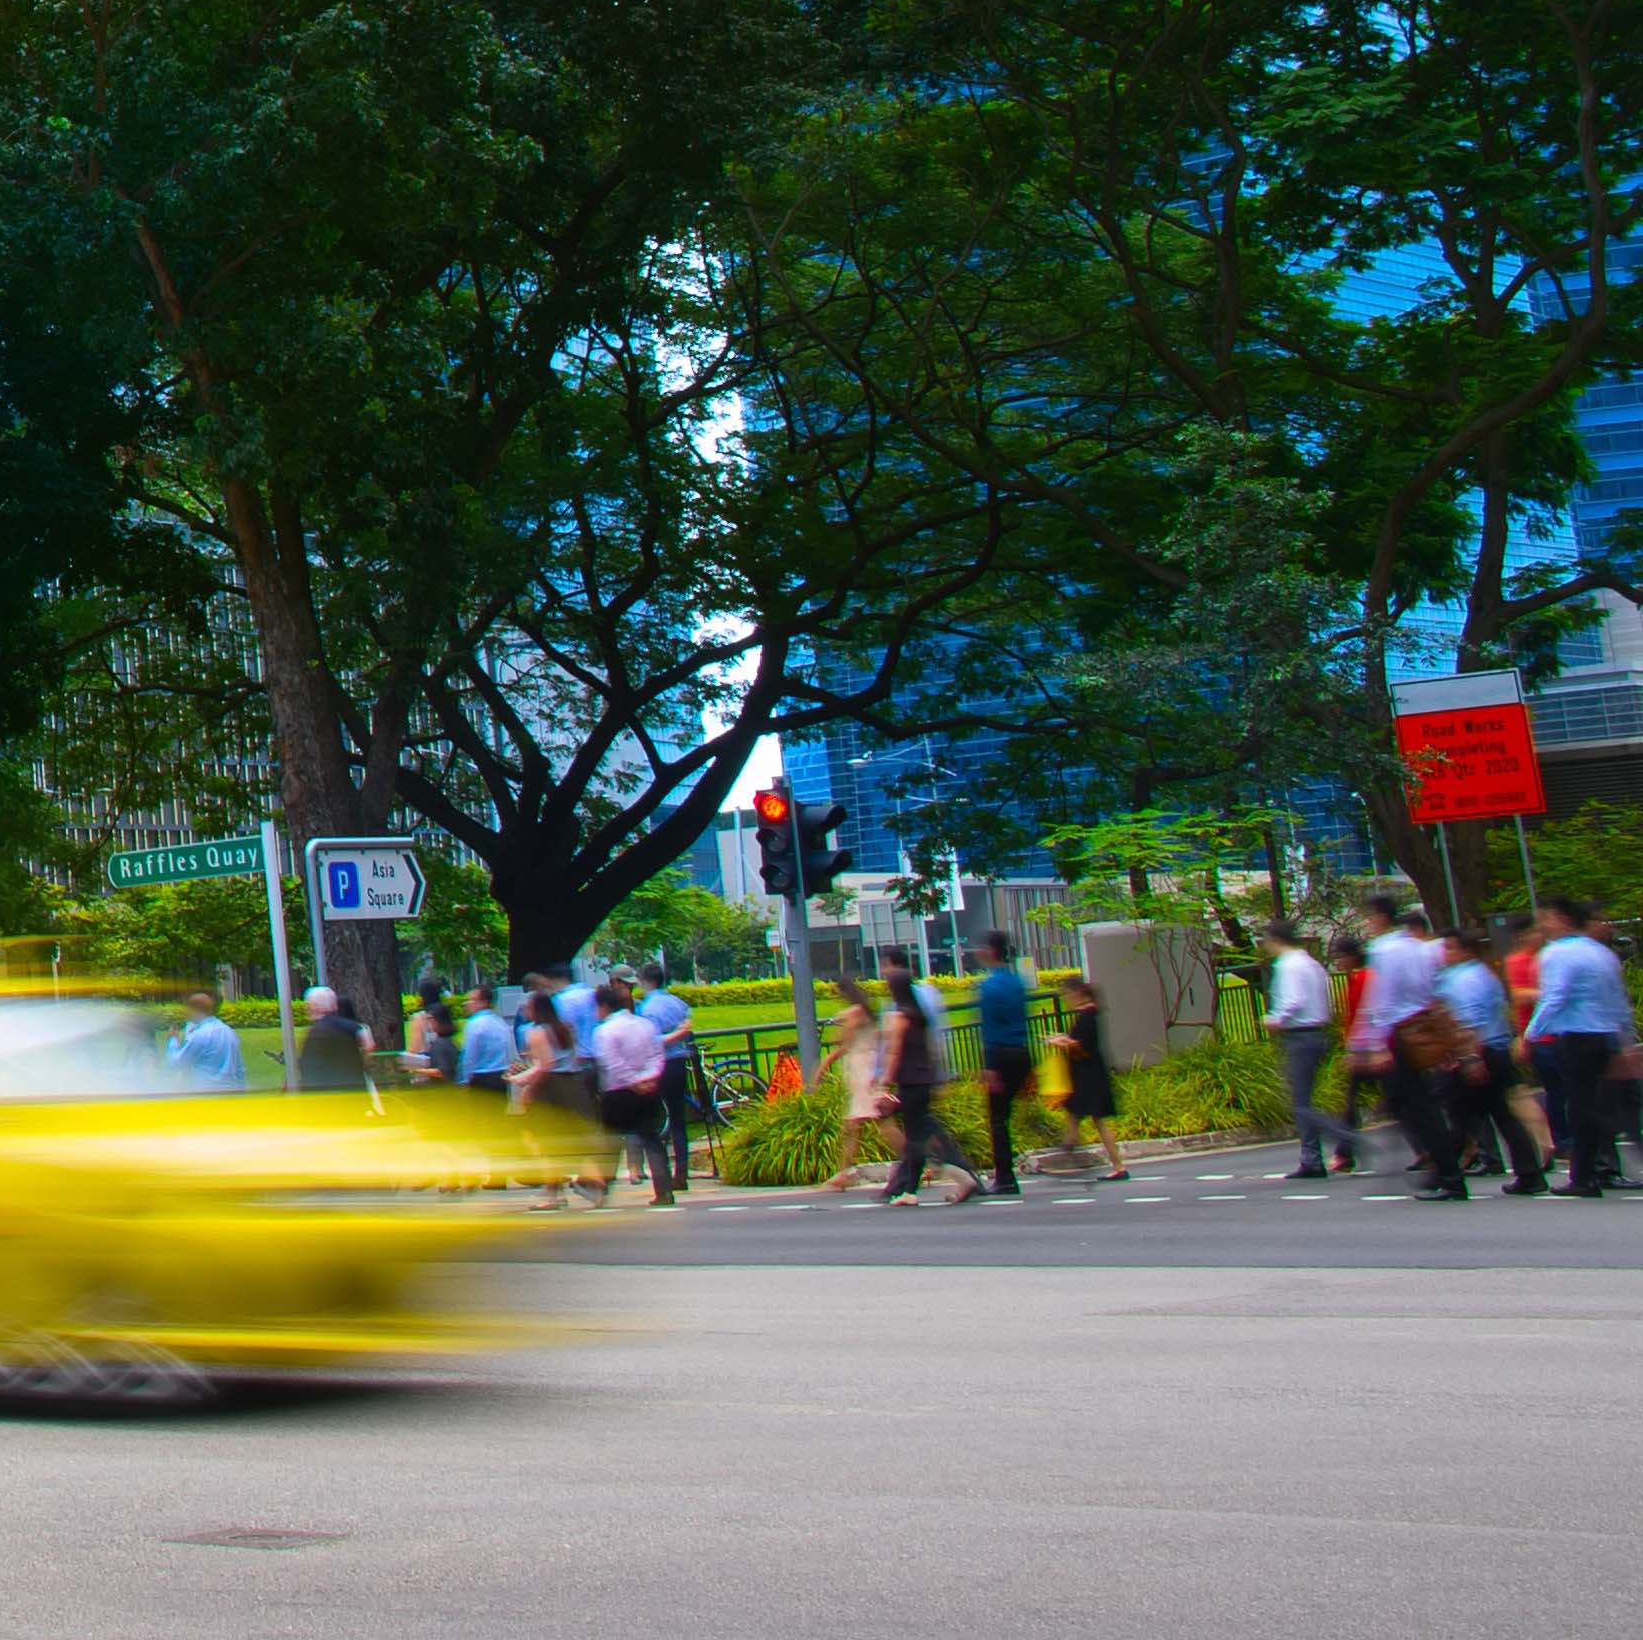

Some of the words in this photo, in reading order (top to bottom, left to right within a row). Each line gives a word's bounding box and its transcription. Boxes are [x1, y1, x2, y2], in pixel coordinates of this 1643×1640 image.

[1421, 722, 1455, 737] Road
[1463, 719, 1505, 734] Works
[1484, 757, 1520, 775] 2020
[119, 852, 198, 879] Raffles
[205, 846, 258, 869] Quay
[371, 859, 395, 879] Asia
[336, 869, 349, 900] P
[366, 887, 405, 909] Square
